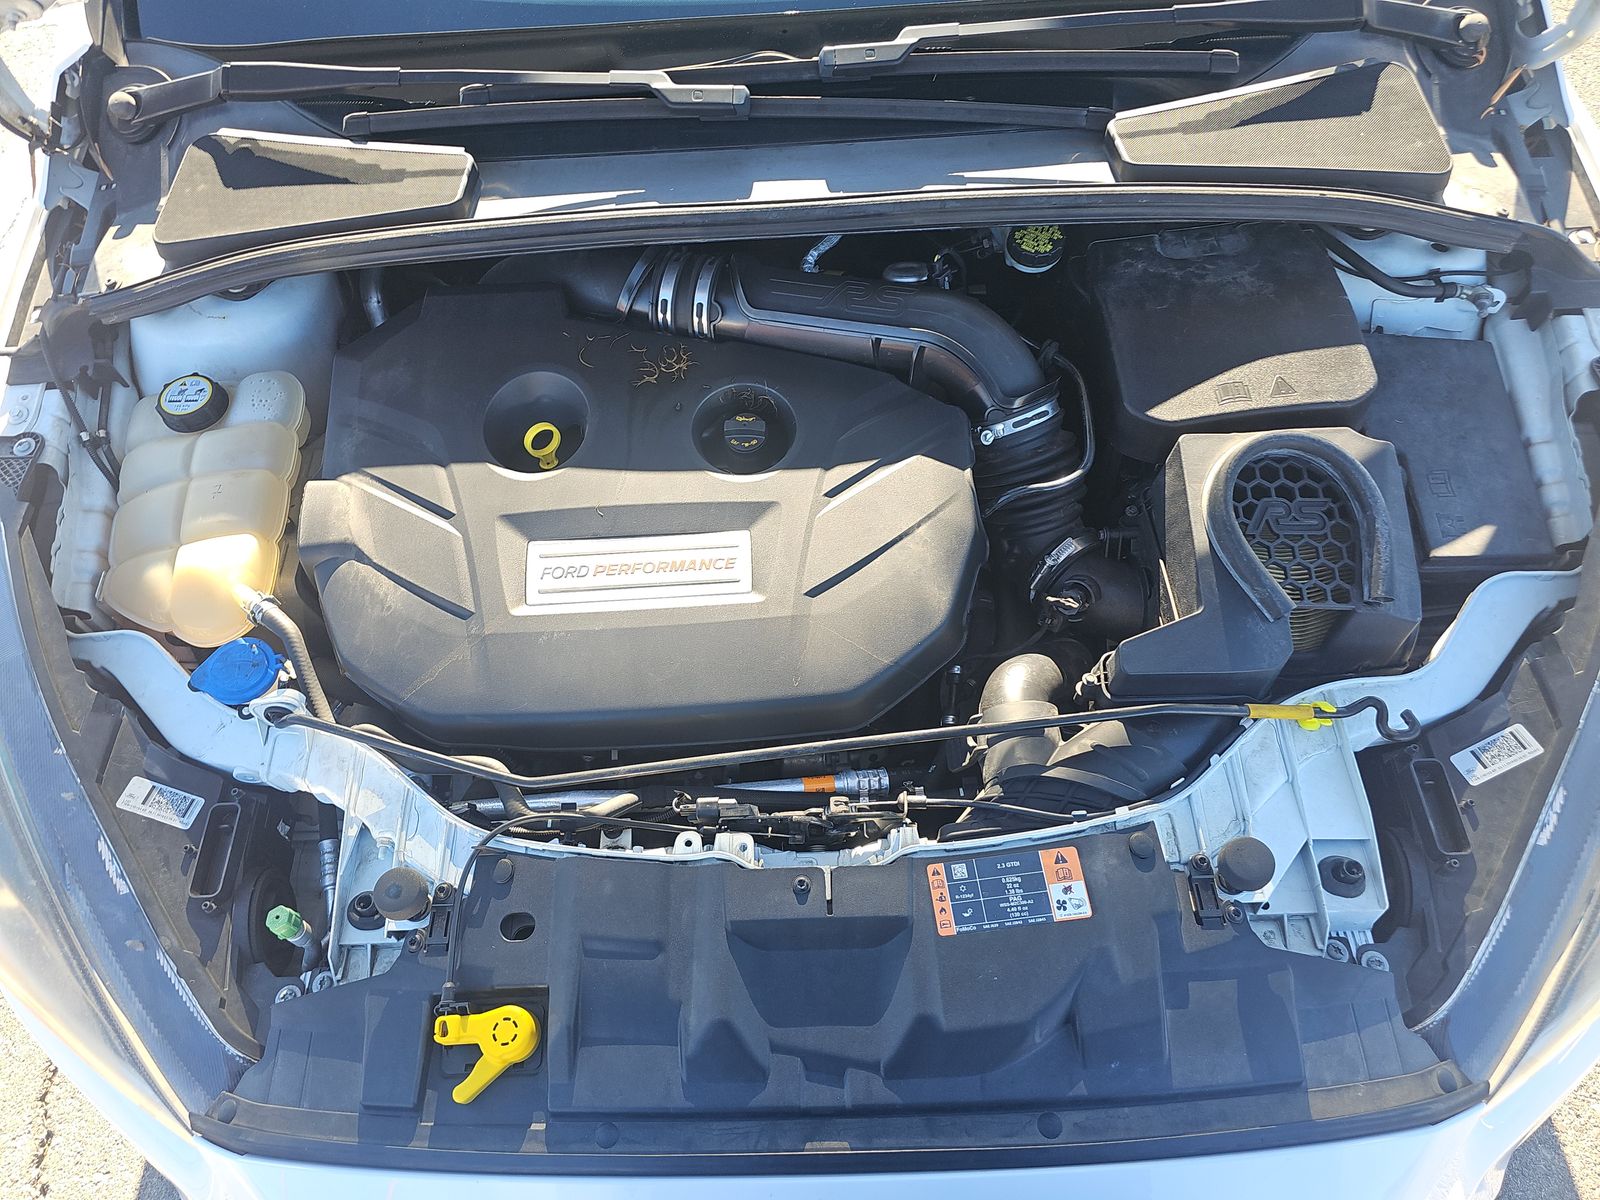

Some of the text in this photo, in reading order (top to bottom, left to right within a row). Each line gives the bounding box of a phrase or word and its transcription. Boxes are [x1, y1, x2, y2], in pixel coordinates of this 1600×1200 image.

[1246, 497, 1332, 535] RS
[540, 556, 738, 580] FORD PERFORMANCE
